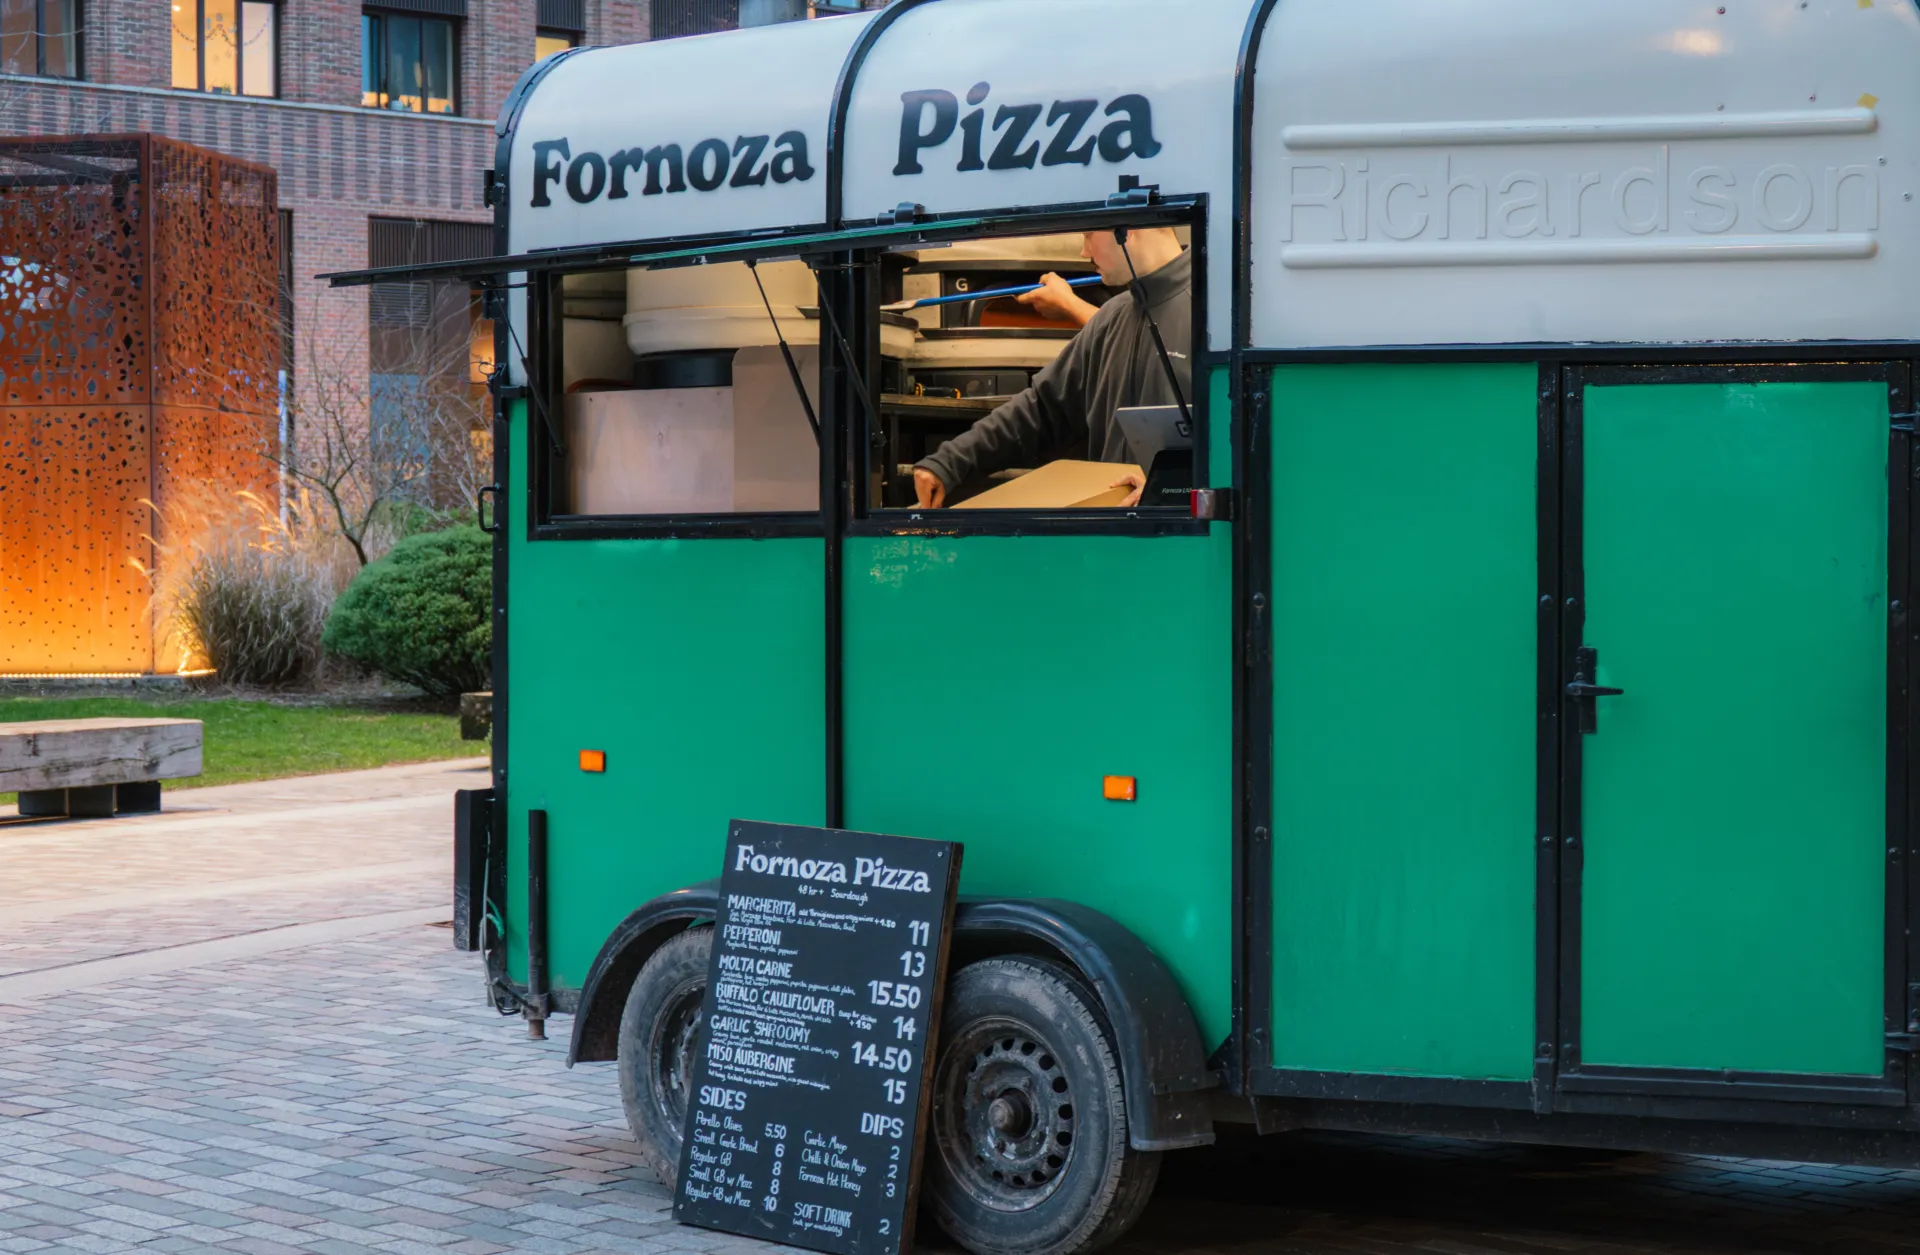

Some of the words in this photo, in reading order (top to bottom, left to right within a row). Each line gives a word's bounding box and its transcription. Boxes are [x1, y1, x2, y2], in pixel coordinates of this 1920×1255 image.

[530, 129, 815, 208] Fornoza
[892, 81, 1162, 176] Pizza
[1280, 145, 1880, 243] Richardson
[956, 277, 969, 292] G
[735, 845, 848, 883] Fornoza
[852, 857, 931, 893] Pizza
[727, 894, 796, 916] MARGHERITA
[798, 885, 808, 895] 48
[830, 888, 869, 906] Sourdough
[723, 924, 781, 945] PEPPERONI
[908, 920, 930, 946] 11
[719, 954, 754, 973] MOLTA
[756, 960, 793, 978] CARNE
[900, 951, 926, 977] 13
[716, 982, 759, 1003] BUFFALO
[762, 991, 835, 1017] CAULIFLOWER
[868, 980, 921, 1009] 15.50
[710, 1015, 751, 1033] GARLIC
[753, 1020, 811, 1043] 'SHROOMY
[893, 1016, 916, 1041] 14
[707, 1043, 733, 1061] MISO
[734, 1047, 795, 1073] AUBERGINE
[851, 1041, 912, 1073] 14.50
[699, 1085, 747, 1111] SIDES
[883, 1079, 907, 1104] 15
[696, 1110, 721, 1128] Perello
[724, 1116, 743, 1132] Olives
[765, 1122, 787, 1139] 5.50
[861, 1112, 905, 1139] DIPS
[694, 1129, 716, 1145] Small
[739, 1136, 758, 1153] Bread
[774, 1143, 785, 1158] 6
[828, 1135, 847, 1155] Mayo
[890, 1145, 900, 1160] 2
[691, 1146, 718, 1166] Regular
[720, 1152, 732, 1166] GB
[772, 1161, 782, 1176] 8
[802, 1148, 821, 1165] Chilli
[823, 1152, 830, 1166] &
[831, 1154, 850, 1171] Onion
[851, 1158, 867, 1177] Mayo
[689, 1164, 710, 1181] Small
[714, 1168, 725, 1183] GB
[736, 1173, 753, 1189] Mozz
[826, 1171, 839, 1187] Hot
[841, 1173, 861, 1197] Honey
[887, 1164, 898, 1179] 2
[685, 1180, 711, 1202] Regular
[713, 1187, 724, 1201] GB
[733, 1191, 751, 1207] Mozz
[770, 1179, 779, 1195] 8
[885, 1182, 895, 1197] 3
[763, 1195, 777, 1212] 10
[794, 1202, 823, 1221] SOFT
[824, 1207, 853, 1228] DRINK
[879, 1218, 890, 1235] 2
